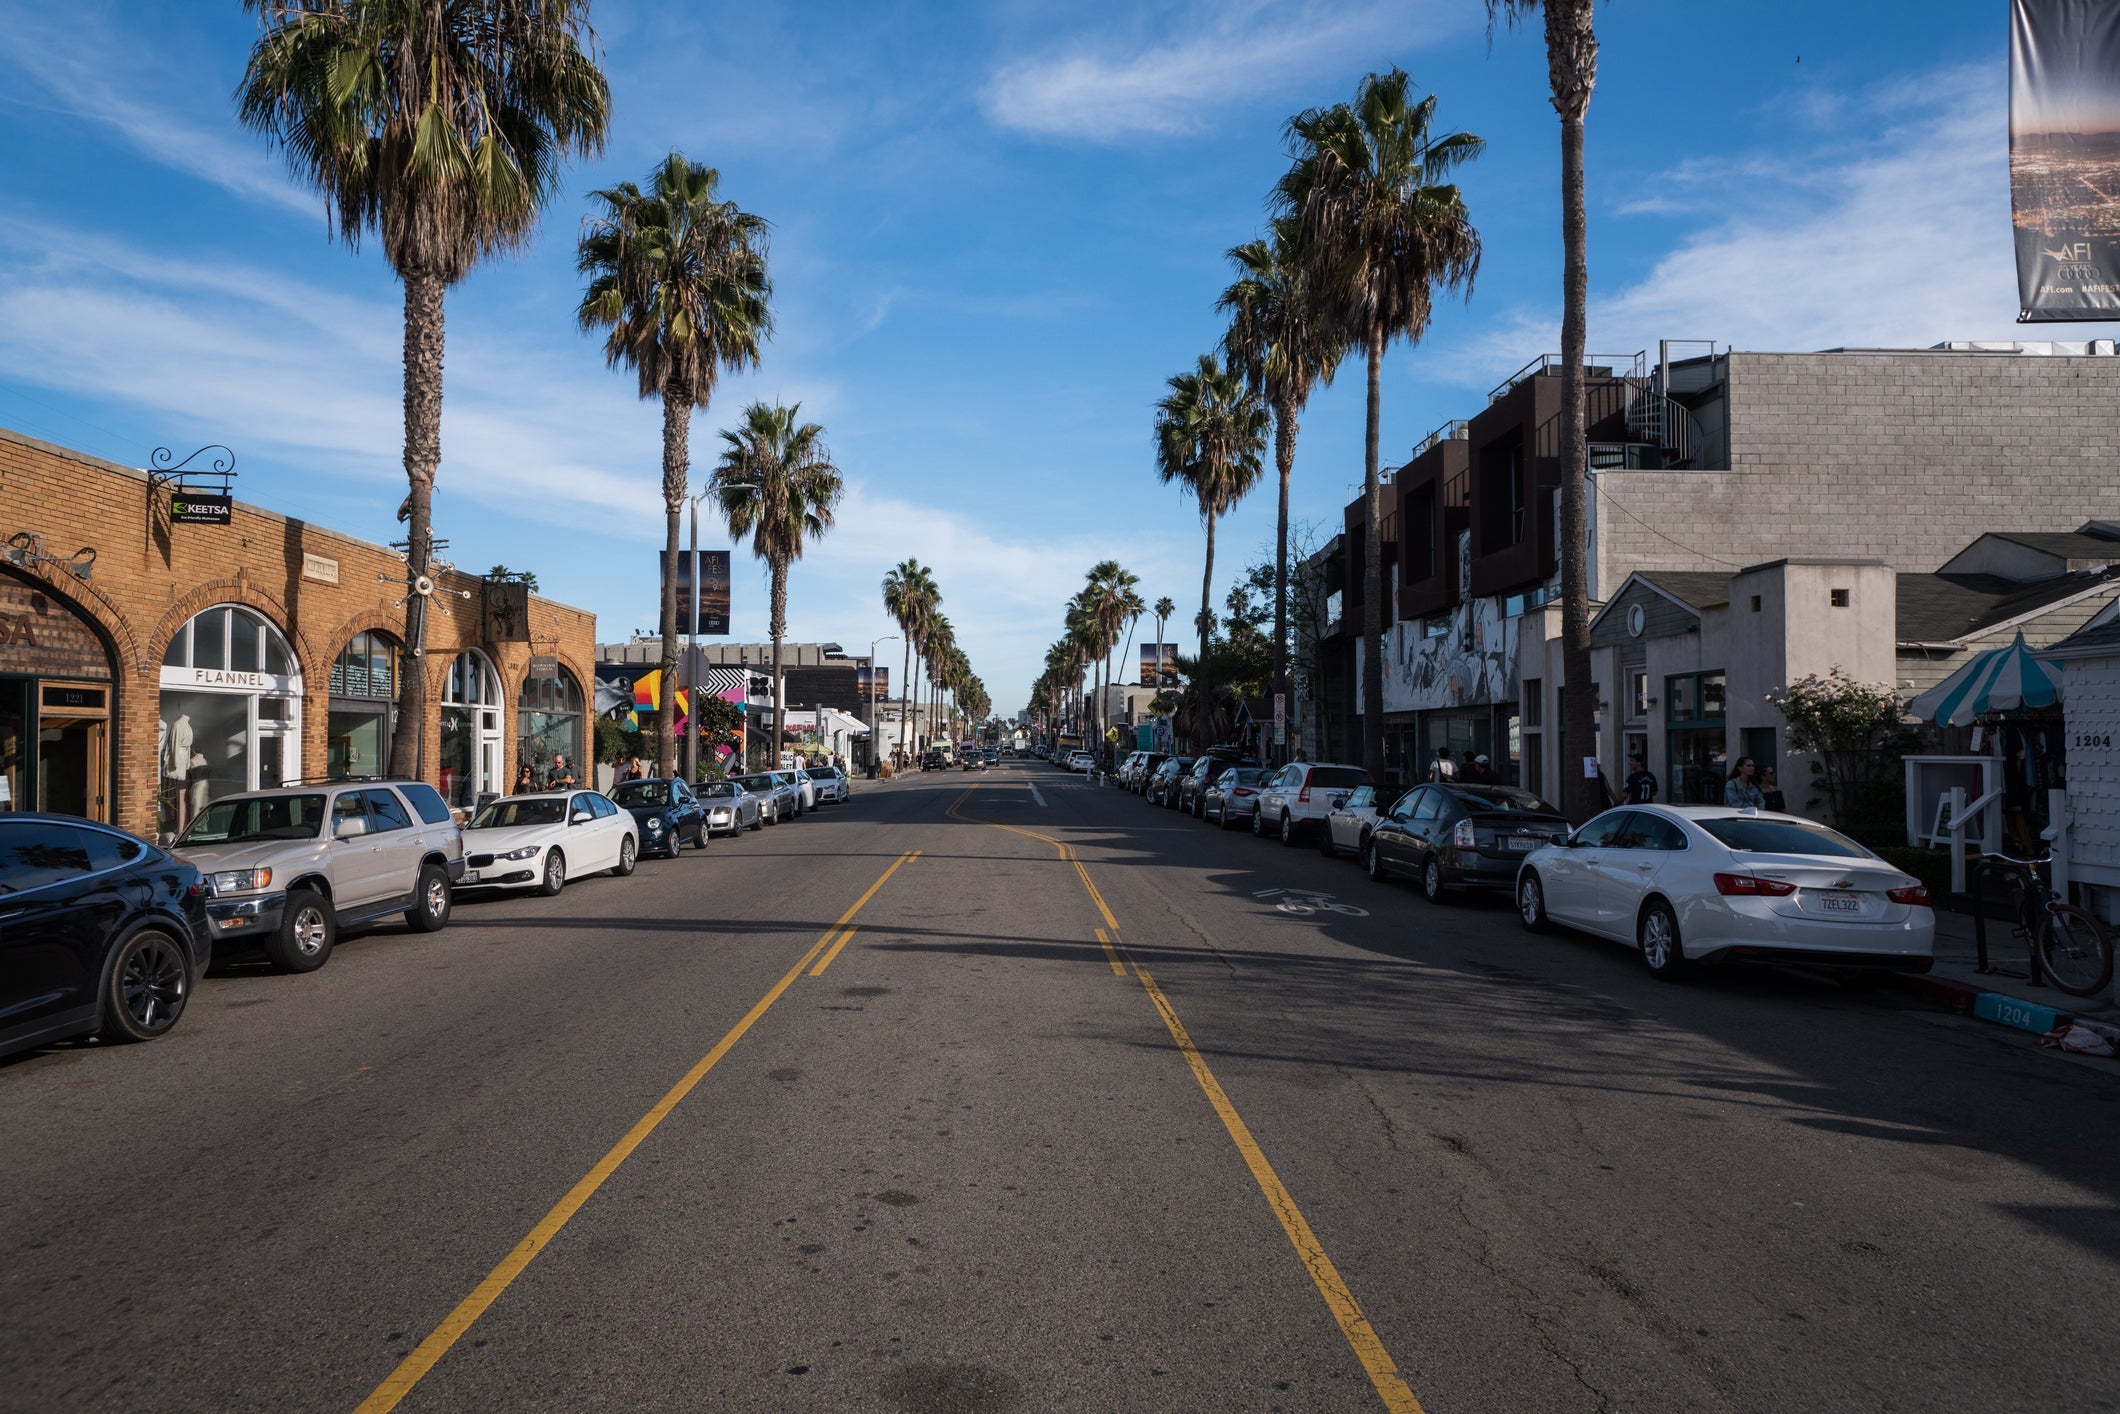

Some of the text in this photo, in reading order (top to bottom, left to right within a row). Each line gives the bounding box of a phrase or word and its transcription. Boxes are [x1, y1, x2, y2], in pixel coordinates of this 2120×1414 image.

[2058, 243, 2091, 261] AFI
[2040, 285, 2073, 294] AFI.com
[187, 504, 229, 515] KEETSA
[705, 555, 719, 564] AFI
[195, 670, 264, 686] FLANNEL
[66, 692, 83, 703] 1221
[2075, 735, 2111, 747] 1204
[1821, 899, 1858, 911] 7ZEL322
[1997, 1004, 2031, 1027] 1204
